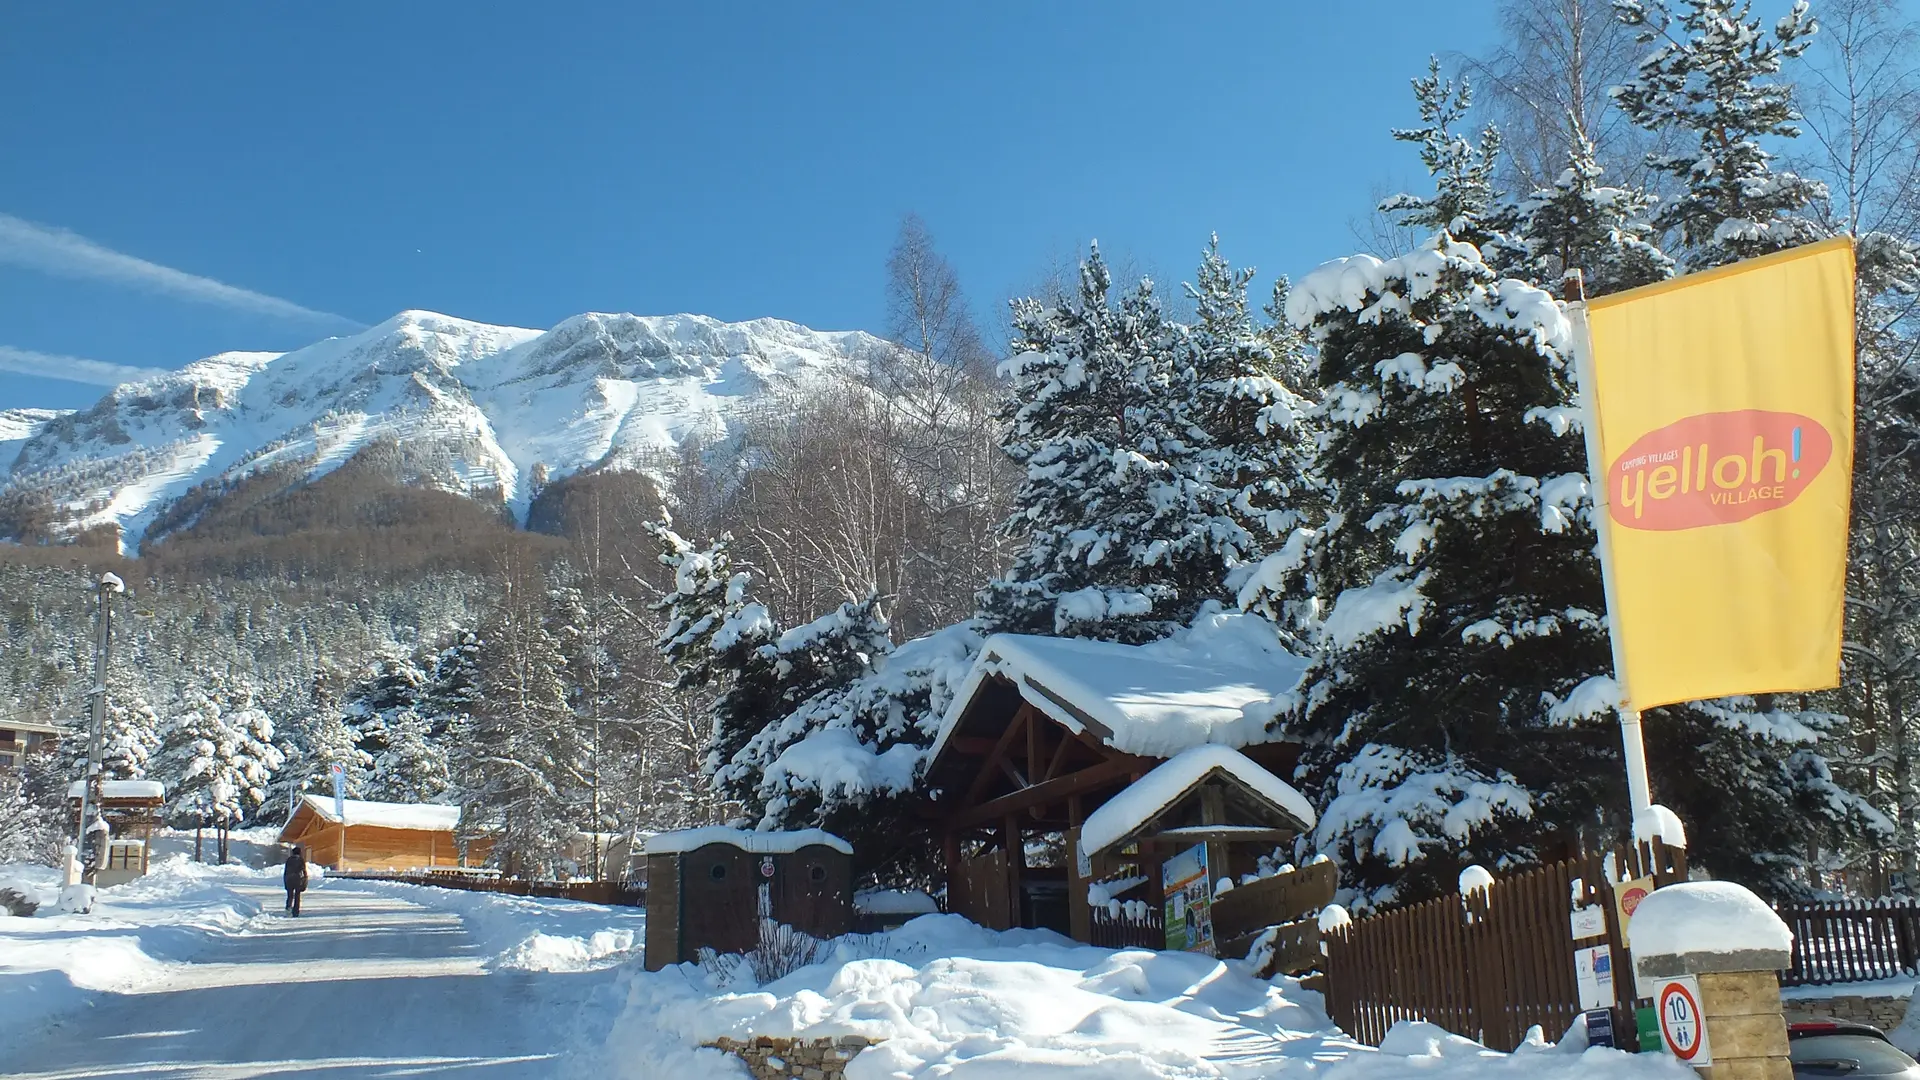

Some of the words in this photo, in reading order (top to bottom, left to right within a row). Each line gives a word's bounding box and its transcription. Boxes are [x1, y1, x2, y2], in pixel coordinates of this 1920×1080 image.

[1621, 456, 1647, 471] CAMPING
[1648, 450, 1679, 463] VILLAGES
[1620, 426, 1802, 519] yelloh!
[1710, 486, 1785, 505] VILLAGE
[1669, 996, 1687, 1021] 10
